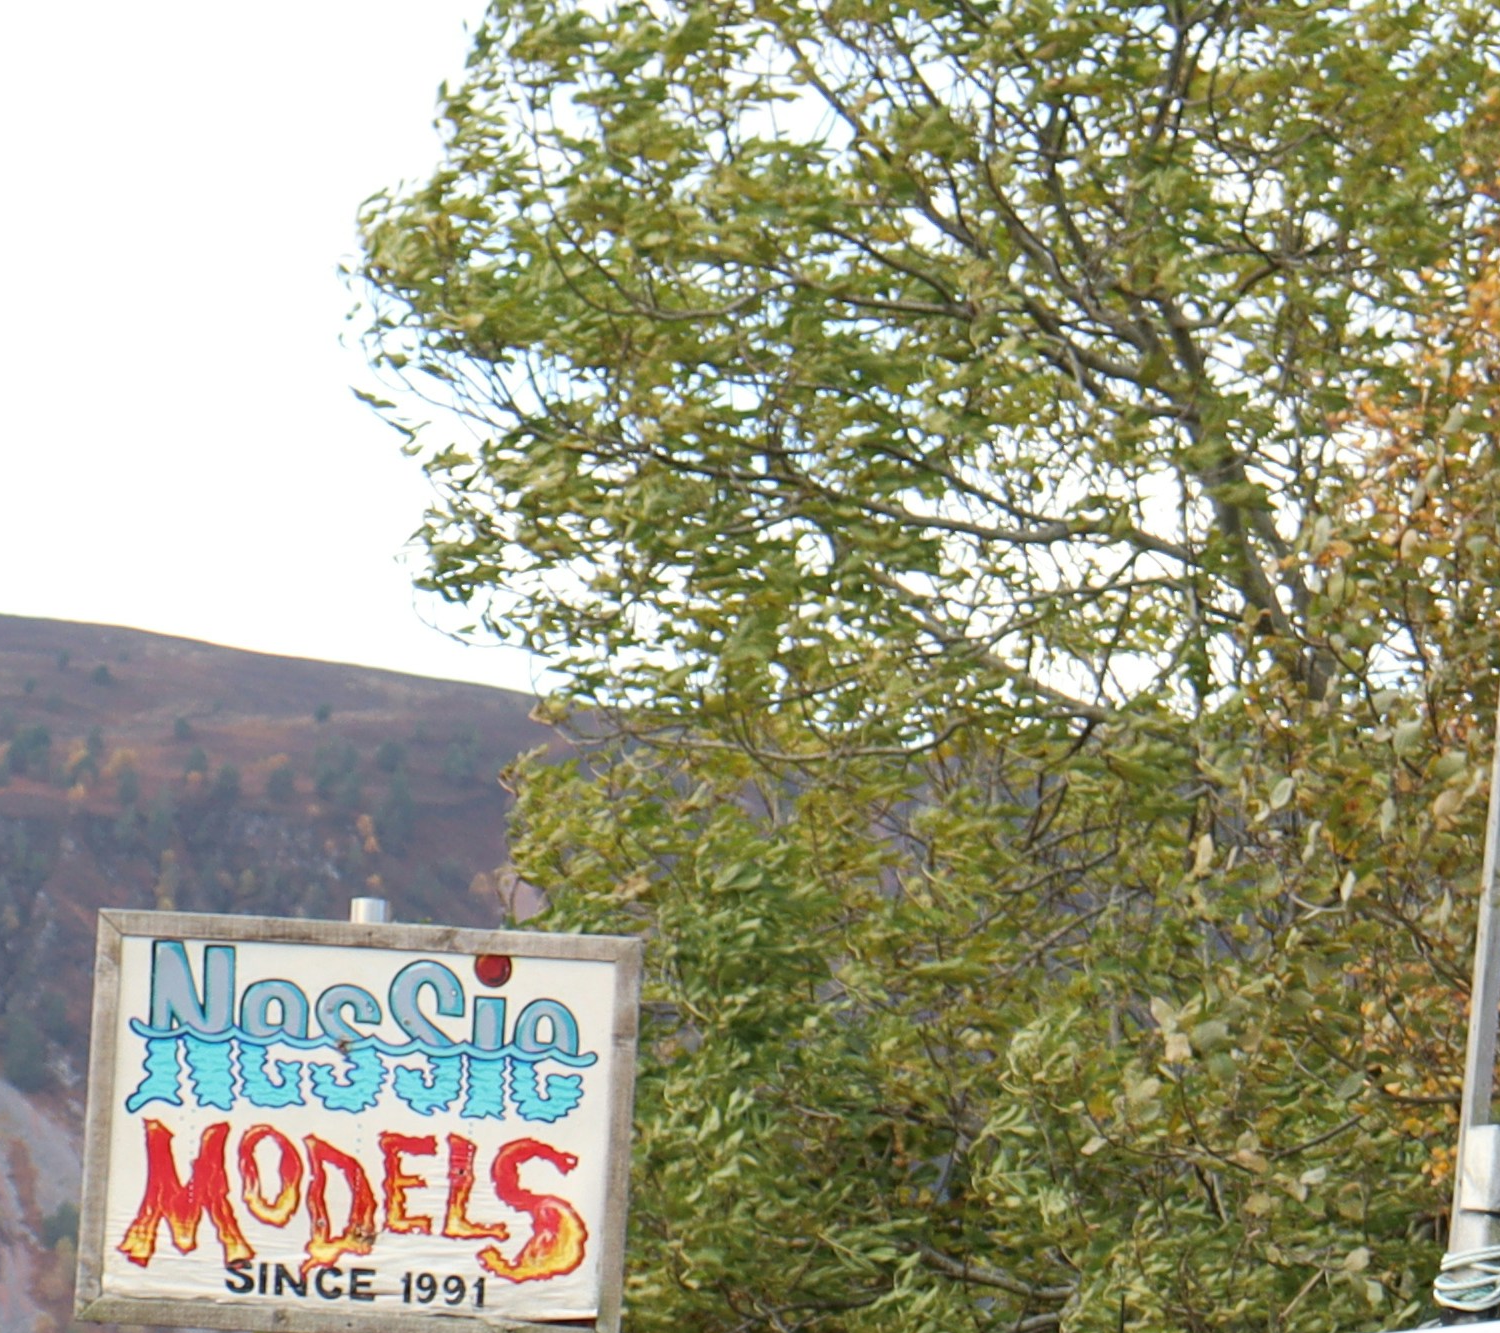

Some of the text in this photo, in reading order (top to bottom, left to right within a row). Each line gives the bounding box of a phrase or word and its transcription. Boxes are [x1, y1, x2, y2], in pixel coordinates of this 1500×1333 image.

[117, 1117, 588, 1283] MODELS
[225, 1258, 487, 1308] SINCE 1991
